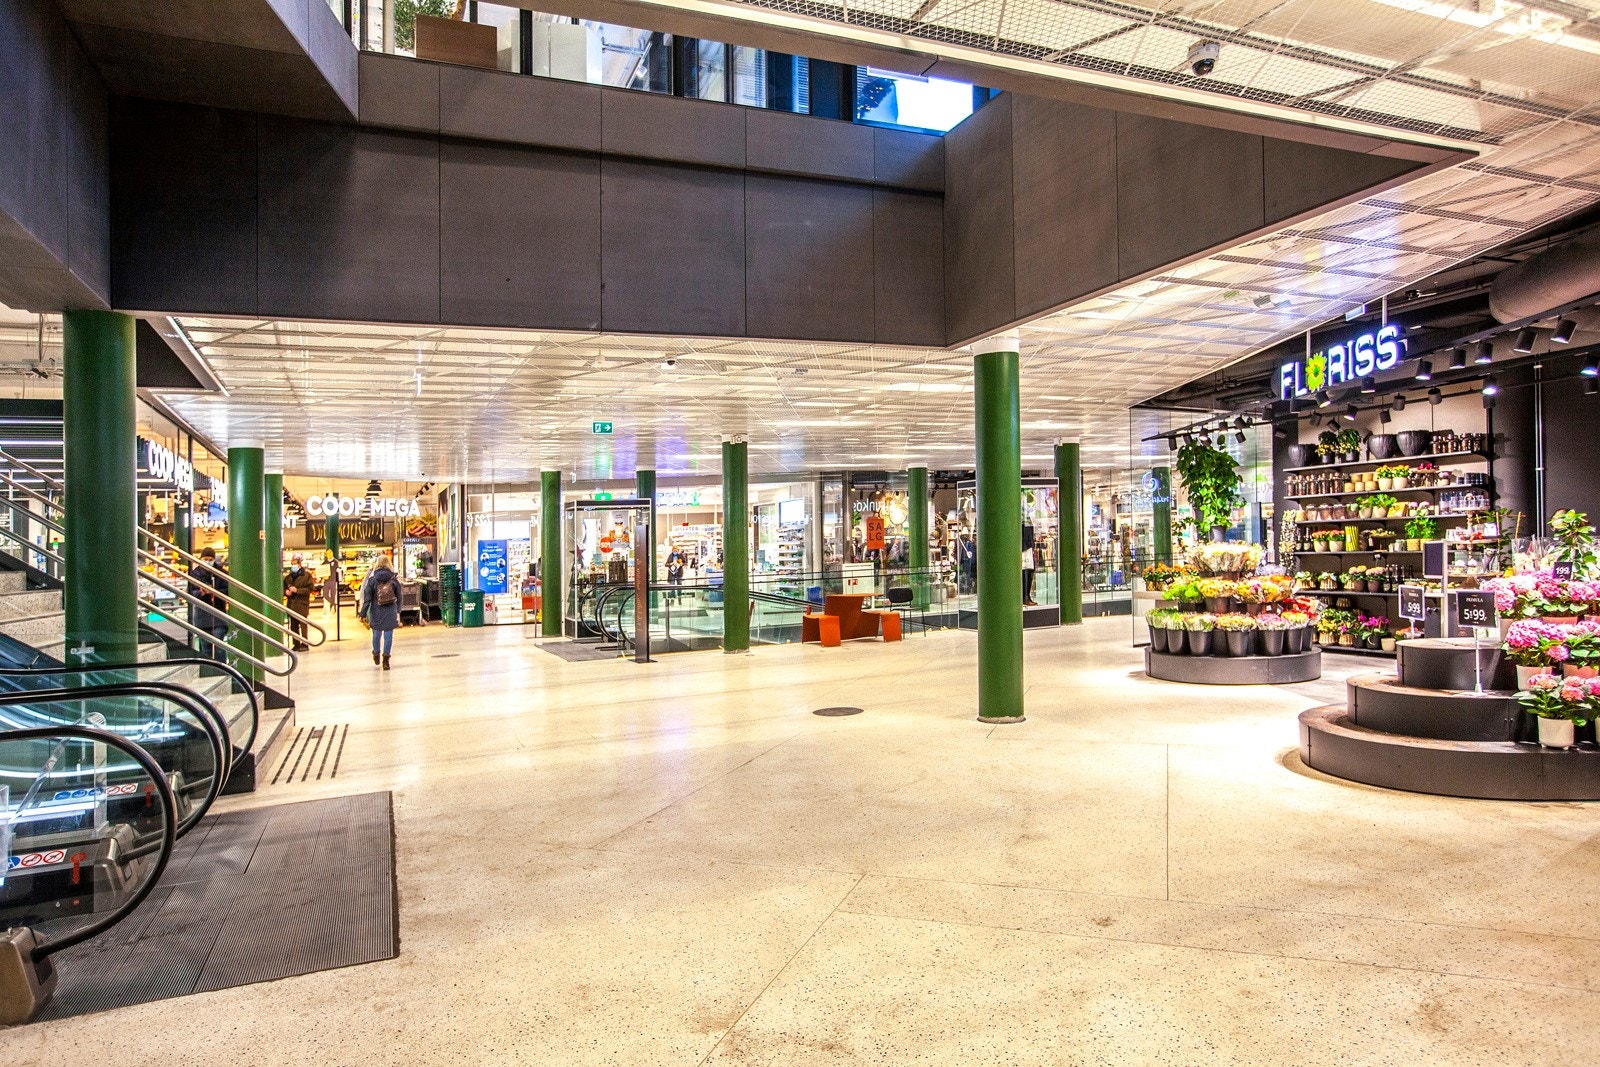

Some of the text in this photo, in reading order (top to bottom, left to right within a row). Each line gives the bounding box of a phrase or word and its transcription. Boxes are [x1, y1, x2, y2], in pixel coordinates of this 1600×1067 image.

[1280, 325, 1399, 400] FLORISS
[148, 440, 174, 483] COOP
[306, 495, 421, 517] COOP MEGA
[868, 522, 882, 531] SA
[869, 532, 882, 541] LG
